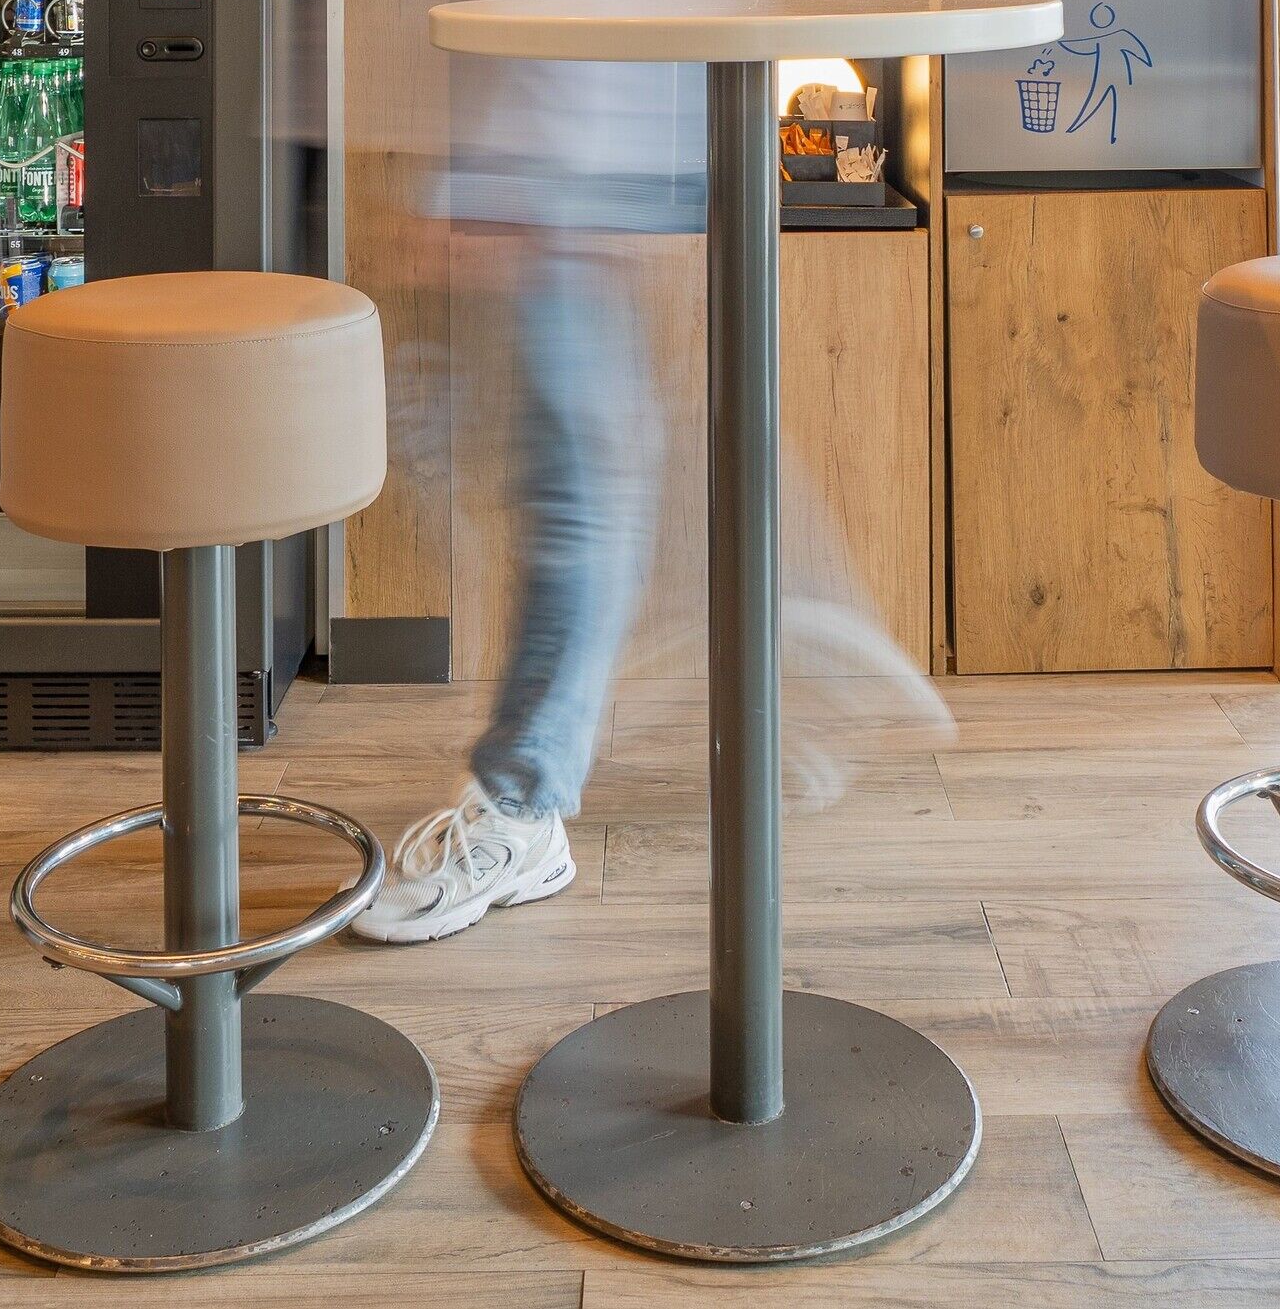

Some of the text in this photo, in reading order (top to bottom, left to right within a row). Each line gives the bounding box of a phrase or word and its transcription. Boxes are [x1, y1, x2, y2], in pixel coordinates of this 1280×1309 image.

[11, 48, 22, 56] 48
[58, 48, 70, 56] 49
[10, 241, 21, 249] 55
